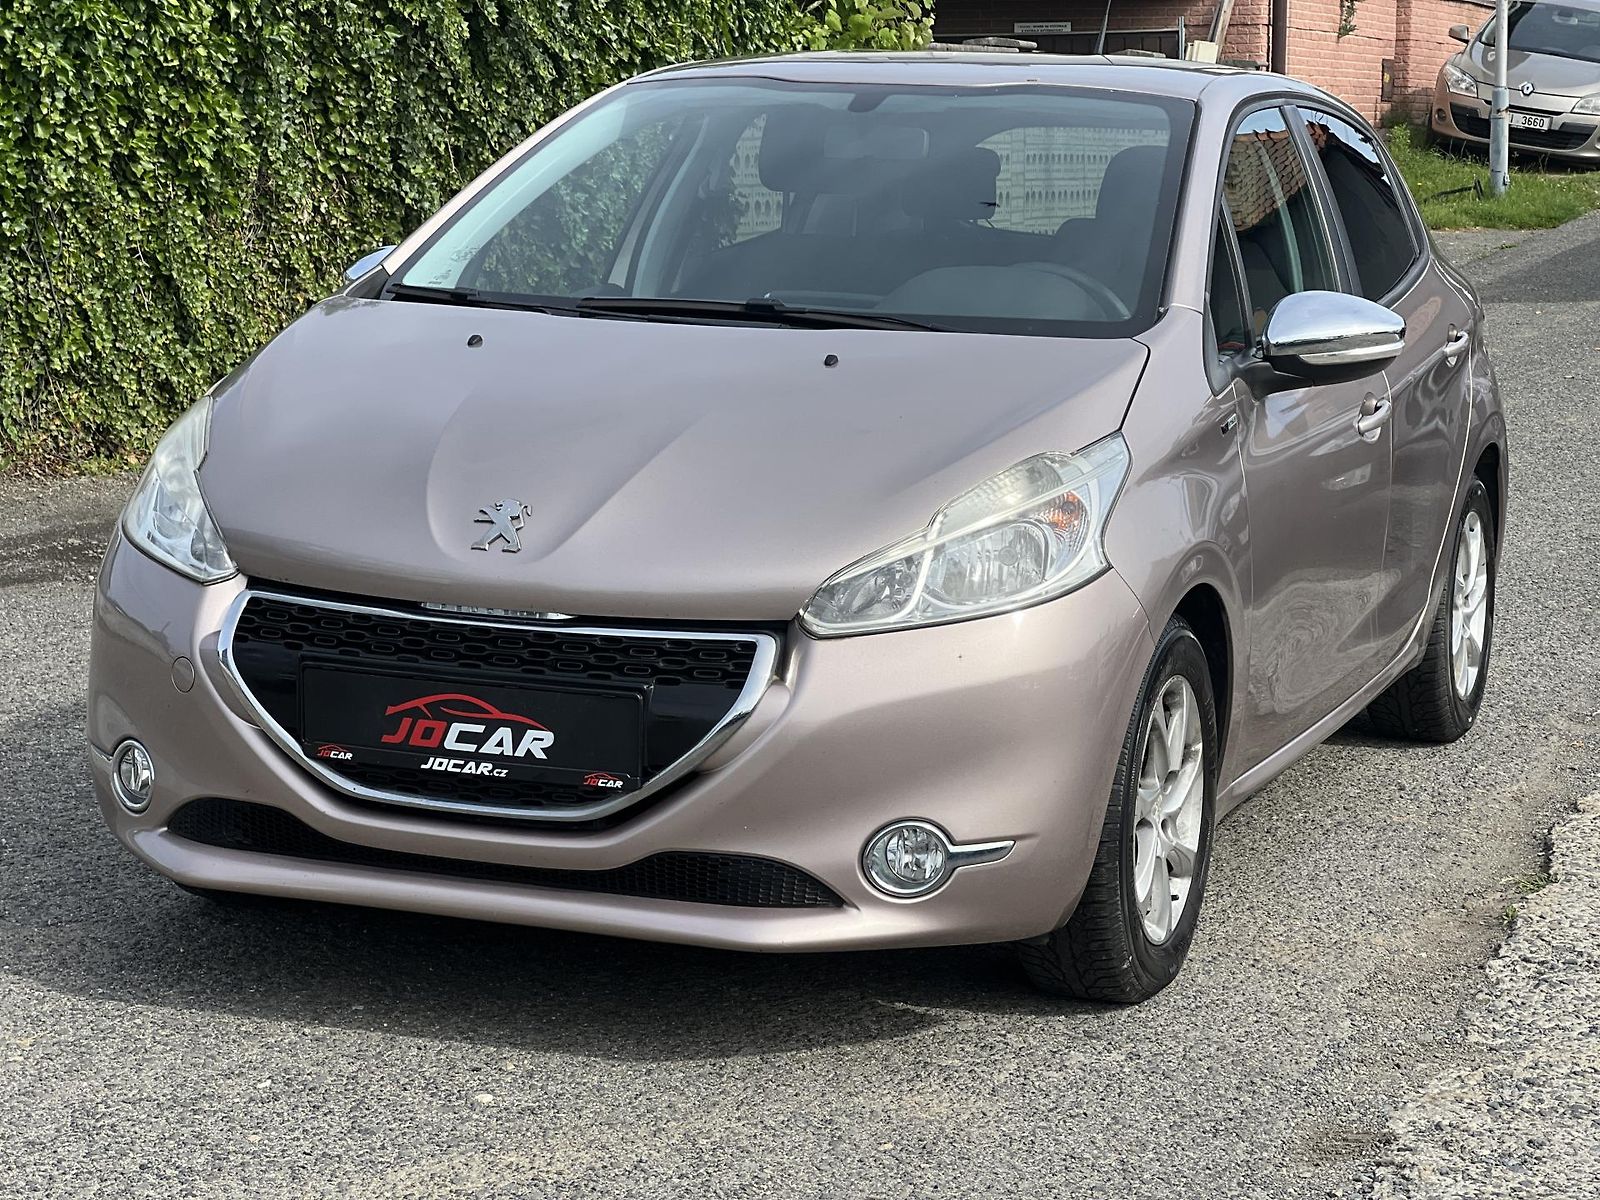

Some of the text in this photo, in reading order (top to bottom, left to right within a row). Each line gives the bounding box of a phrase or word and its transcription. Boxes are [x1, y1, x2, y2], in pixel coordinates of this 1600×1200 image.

[1521, 116, 1545, 127] 3660
[381, 717, 555, 759] JOCAR
[317, 750, 353, 760] JOCAR
[583, 778, 624, 788] JOCAR
